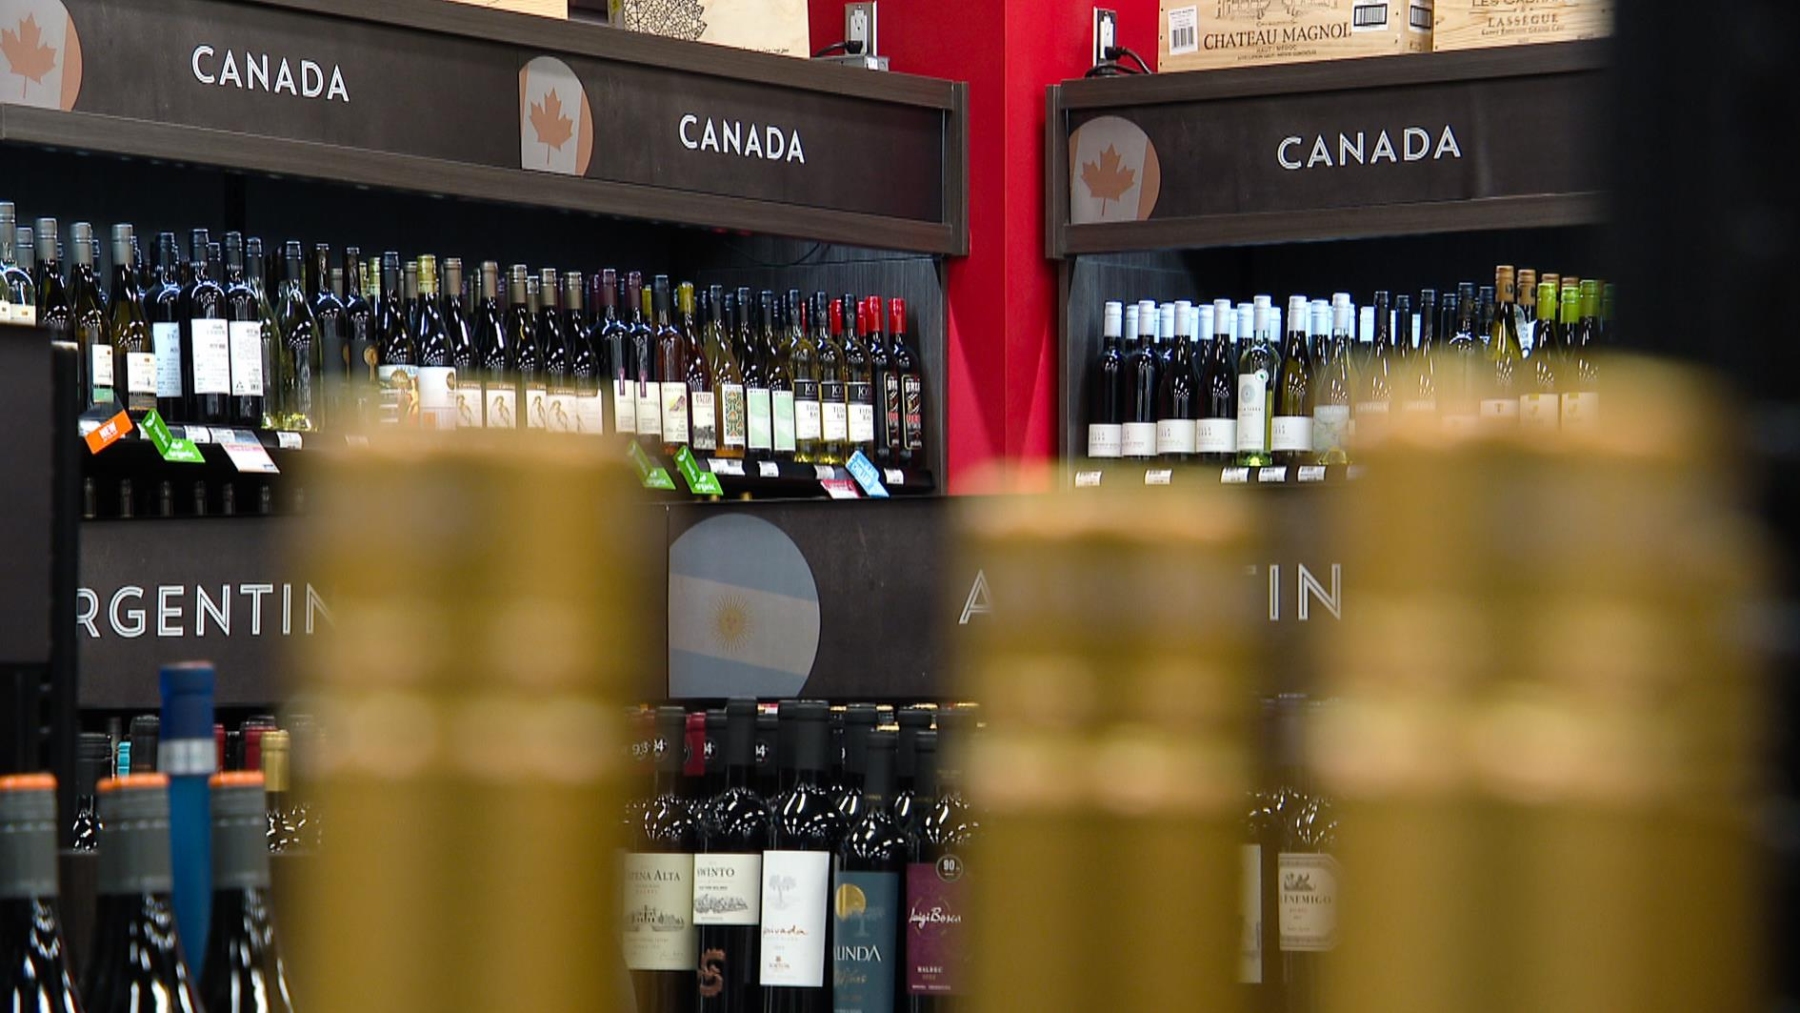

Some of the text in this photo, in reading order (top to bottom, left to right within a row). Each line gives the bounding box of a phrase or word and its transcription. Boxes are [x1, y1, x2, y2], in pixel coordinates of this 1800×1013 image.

[1204, 33, 1277, 51] CHATEAU
[191, 44, 350, 103] CANADA
[678, 113, 806, 166] CANADA
[1276, 124, 1462, 171] CANADA
[77, 583, 335, 638] RGENTIN
